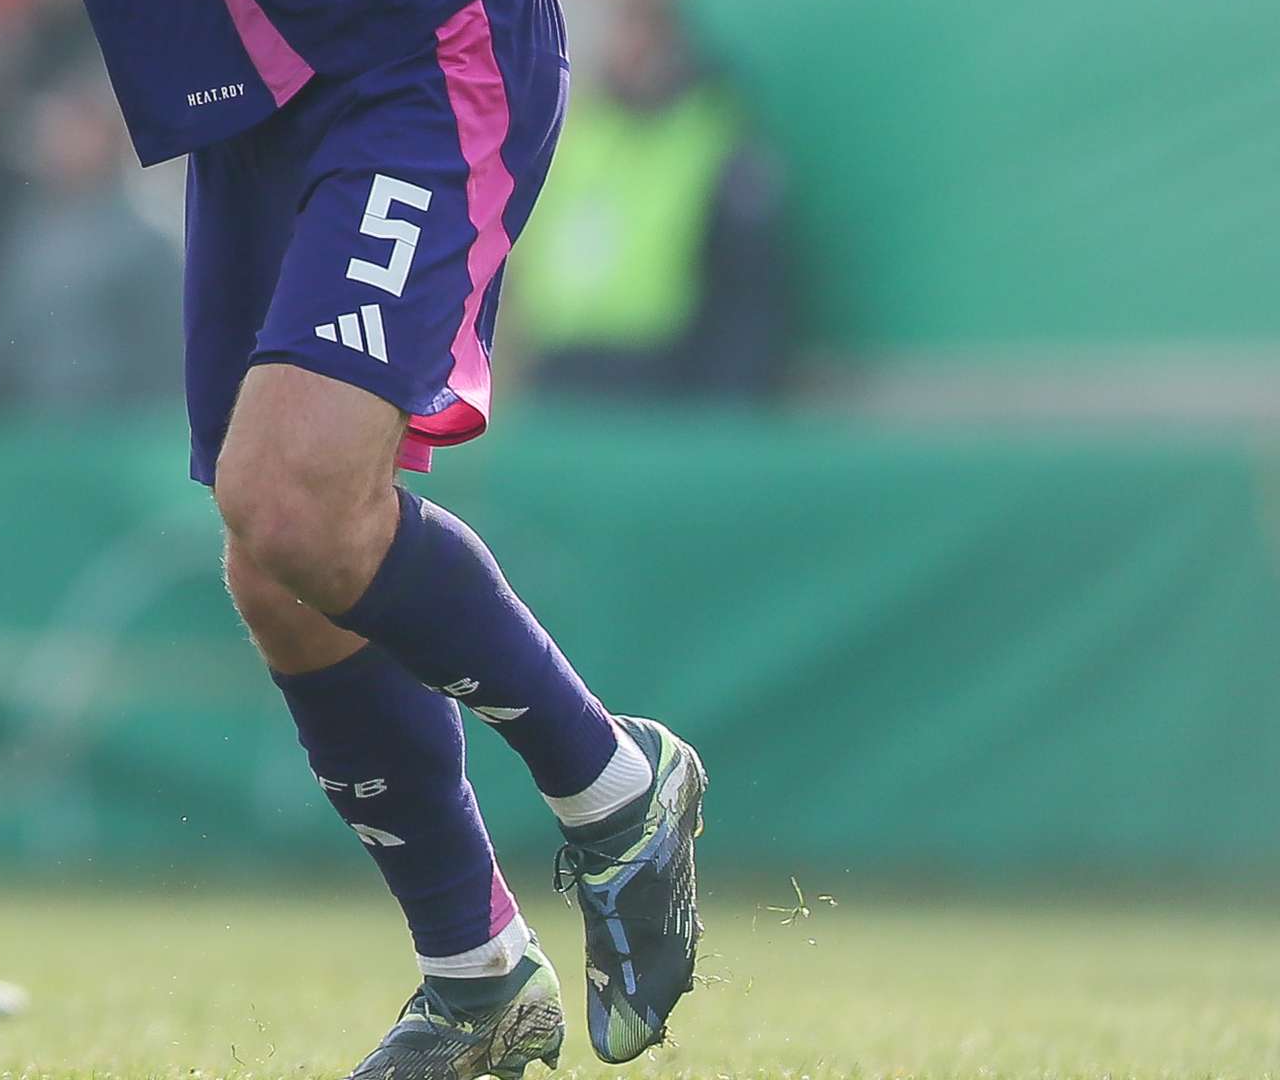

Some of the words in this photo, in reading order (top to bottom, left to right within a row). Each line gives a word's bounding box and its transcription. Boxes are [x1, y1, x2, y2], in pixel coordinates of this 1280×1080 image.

[187, 83, 244, 106] HEAT.RDY
[345, 173, 432, 298] 5
[318, 776, 388, 798] FB
